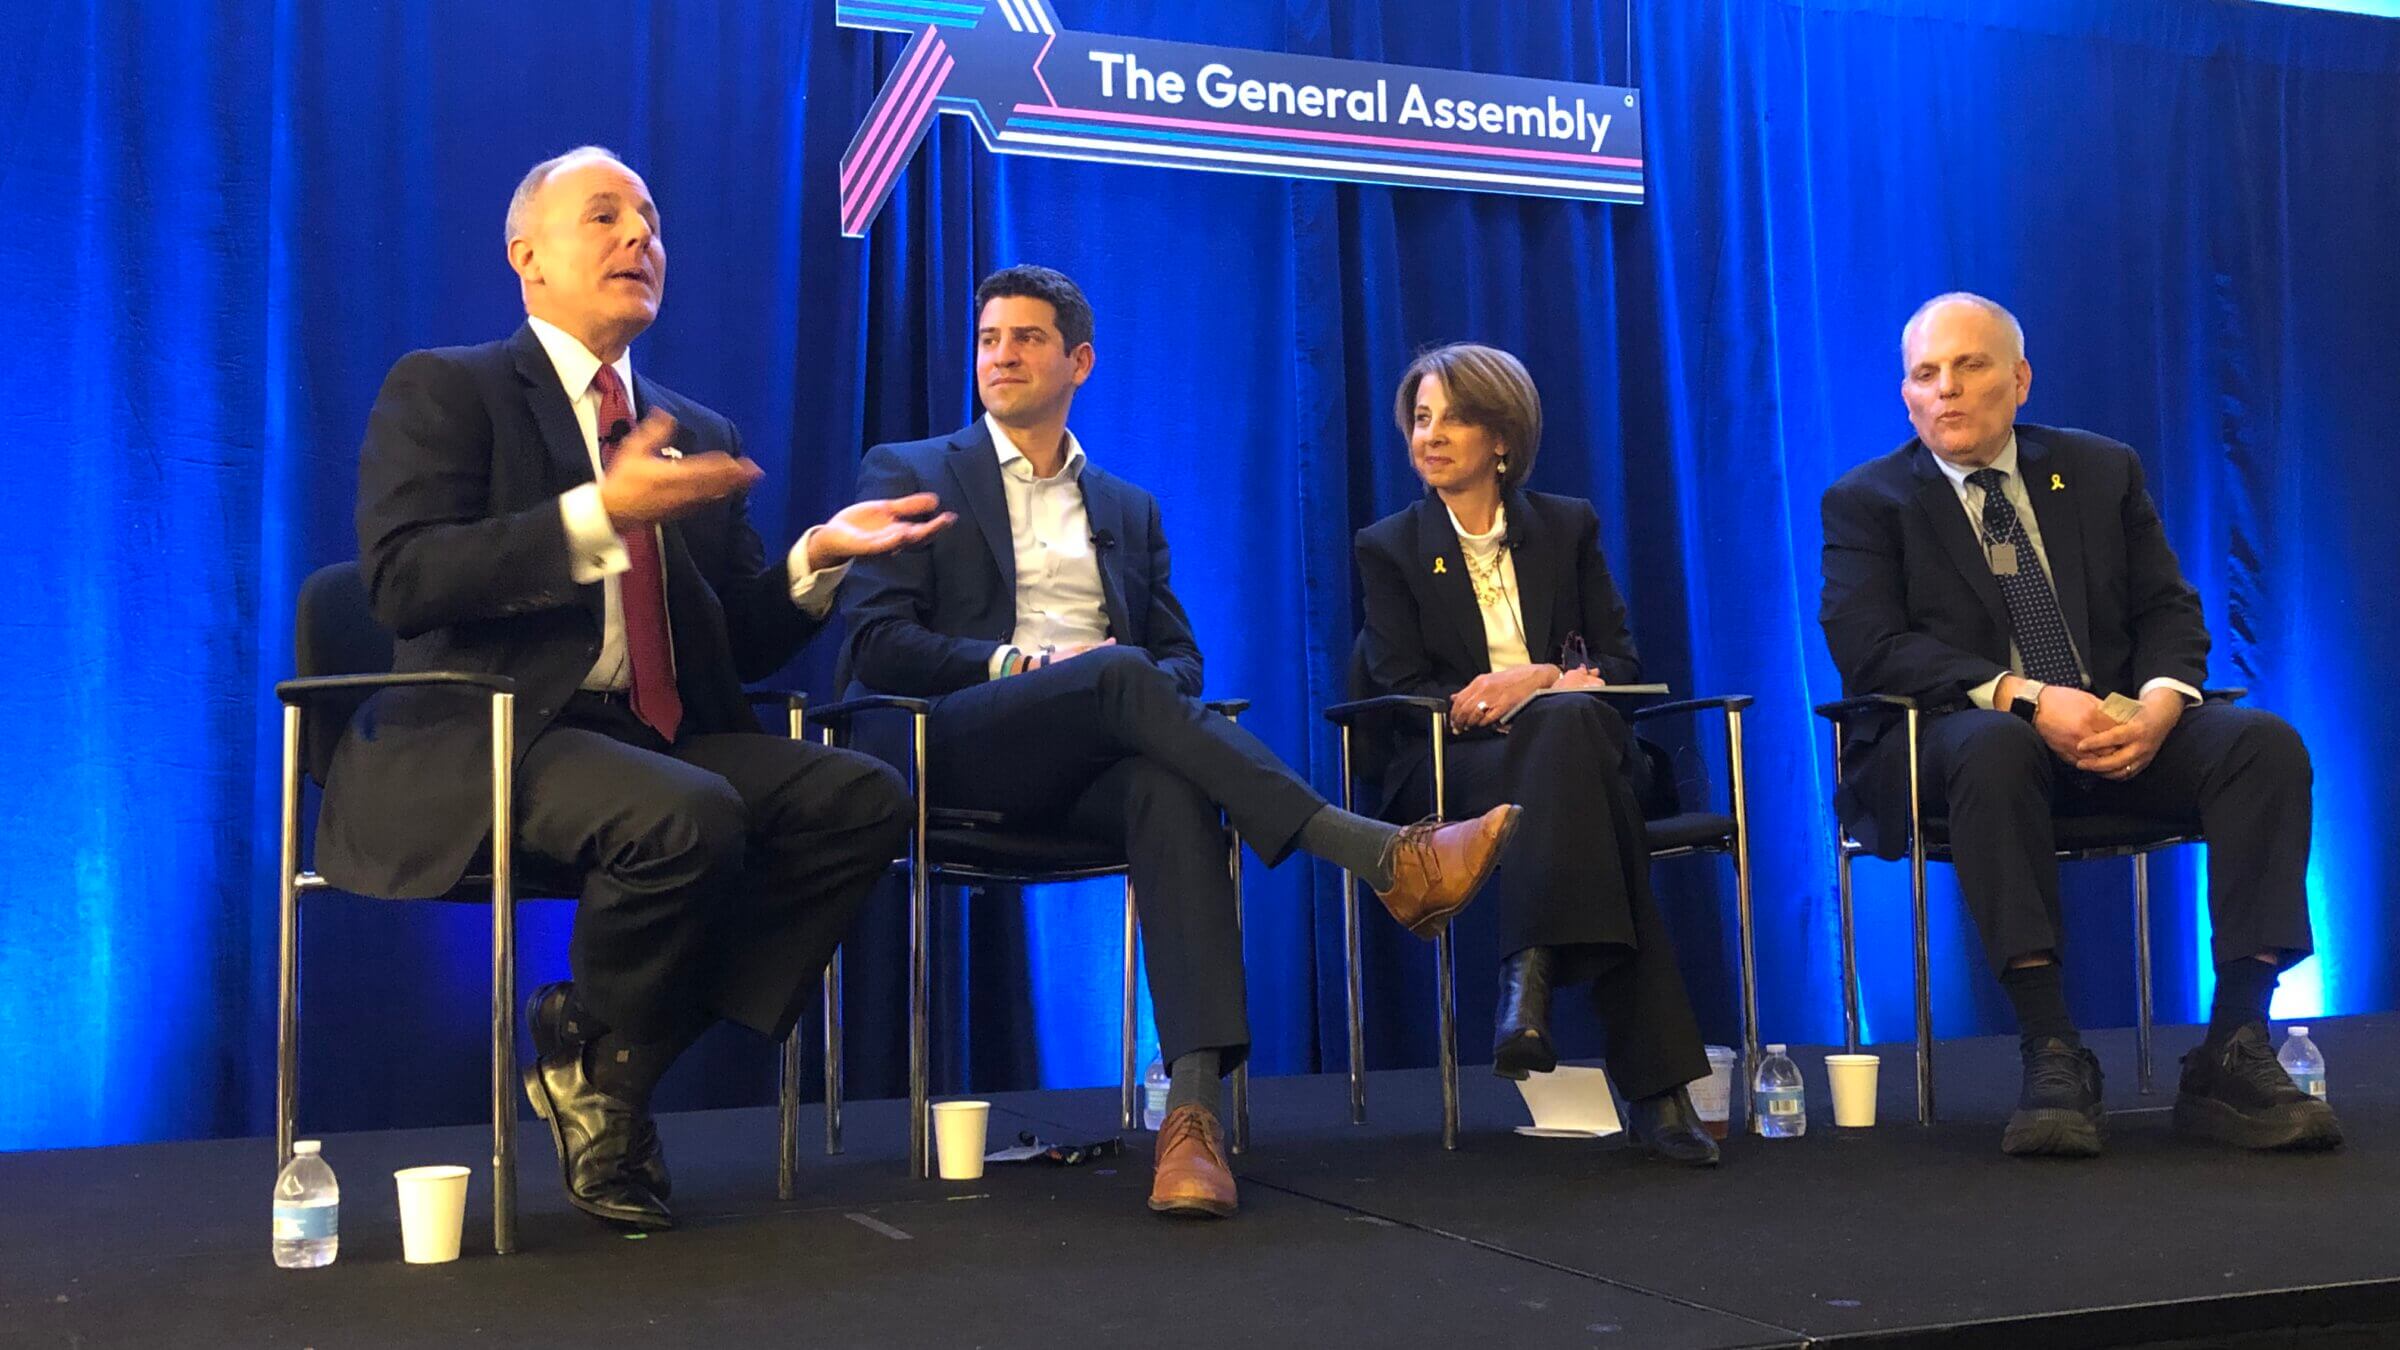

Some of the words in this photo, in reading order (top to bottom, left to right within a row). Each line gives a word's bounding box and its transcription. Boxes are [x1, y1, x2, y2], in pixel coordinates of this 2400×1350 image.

[1088, 50, 1186, 104] The
[1196, 63, 1388, 123] General
[1397, 83, 1612, 153] Assembly
